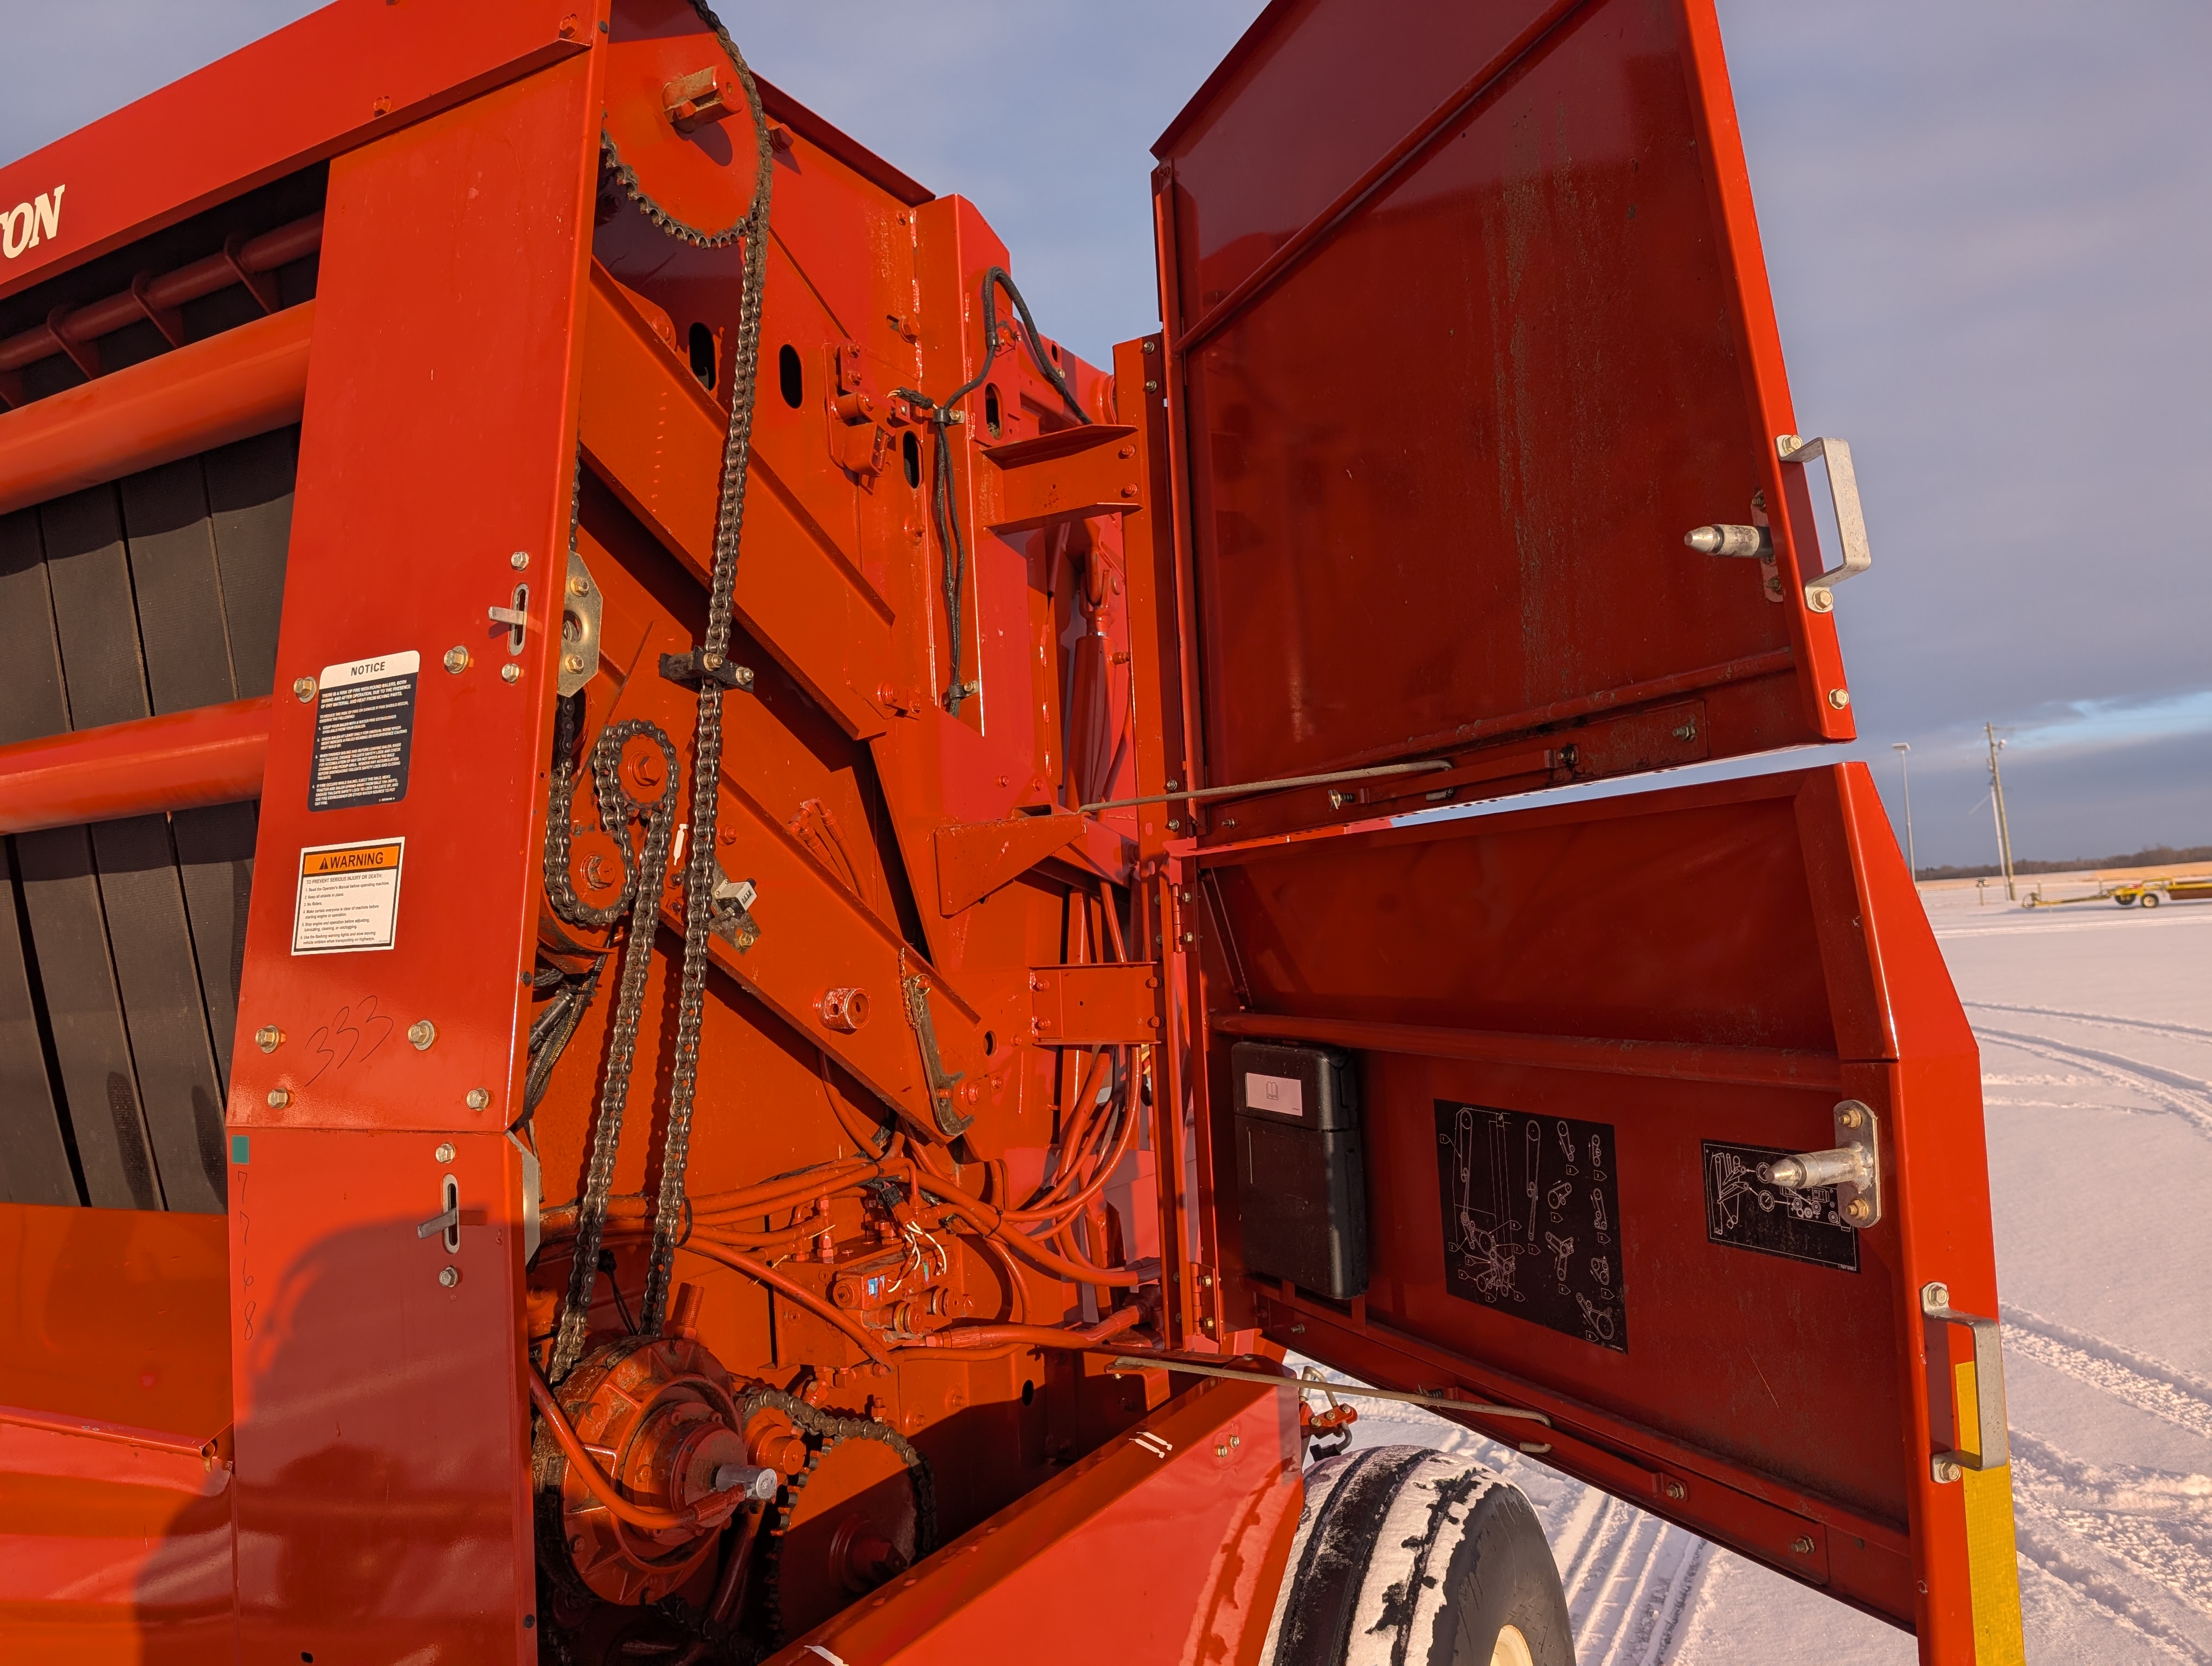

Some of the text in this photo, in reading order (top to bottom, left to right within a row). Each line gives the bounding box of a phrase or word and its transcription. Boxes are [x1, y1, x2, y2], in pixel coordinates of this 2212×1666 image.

[0, 184, 66, 259] ON
[351, 662, 385, 676] NOTICE
[330, 851, 384, 869] WARNING
[304, 995, 394, 1087] 333
